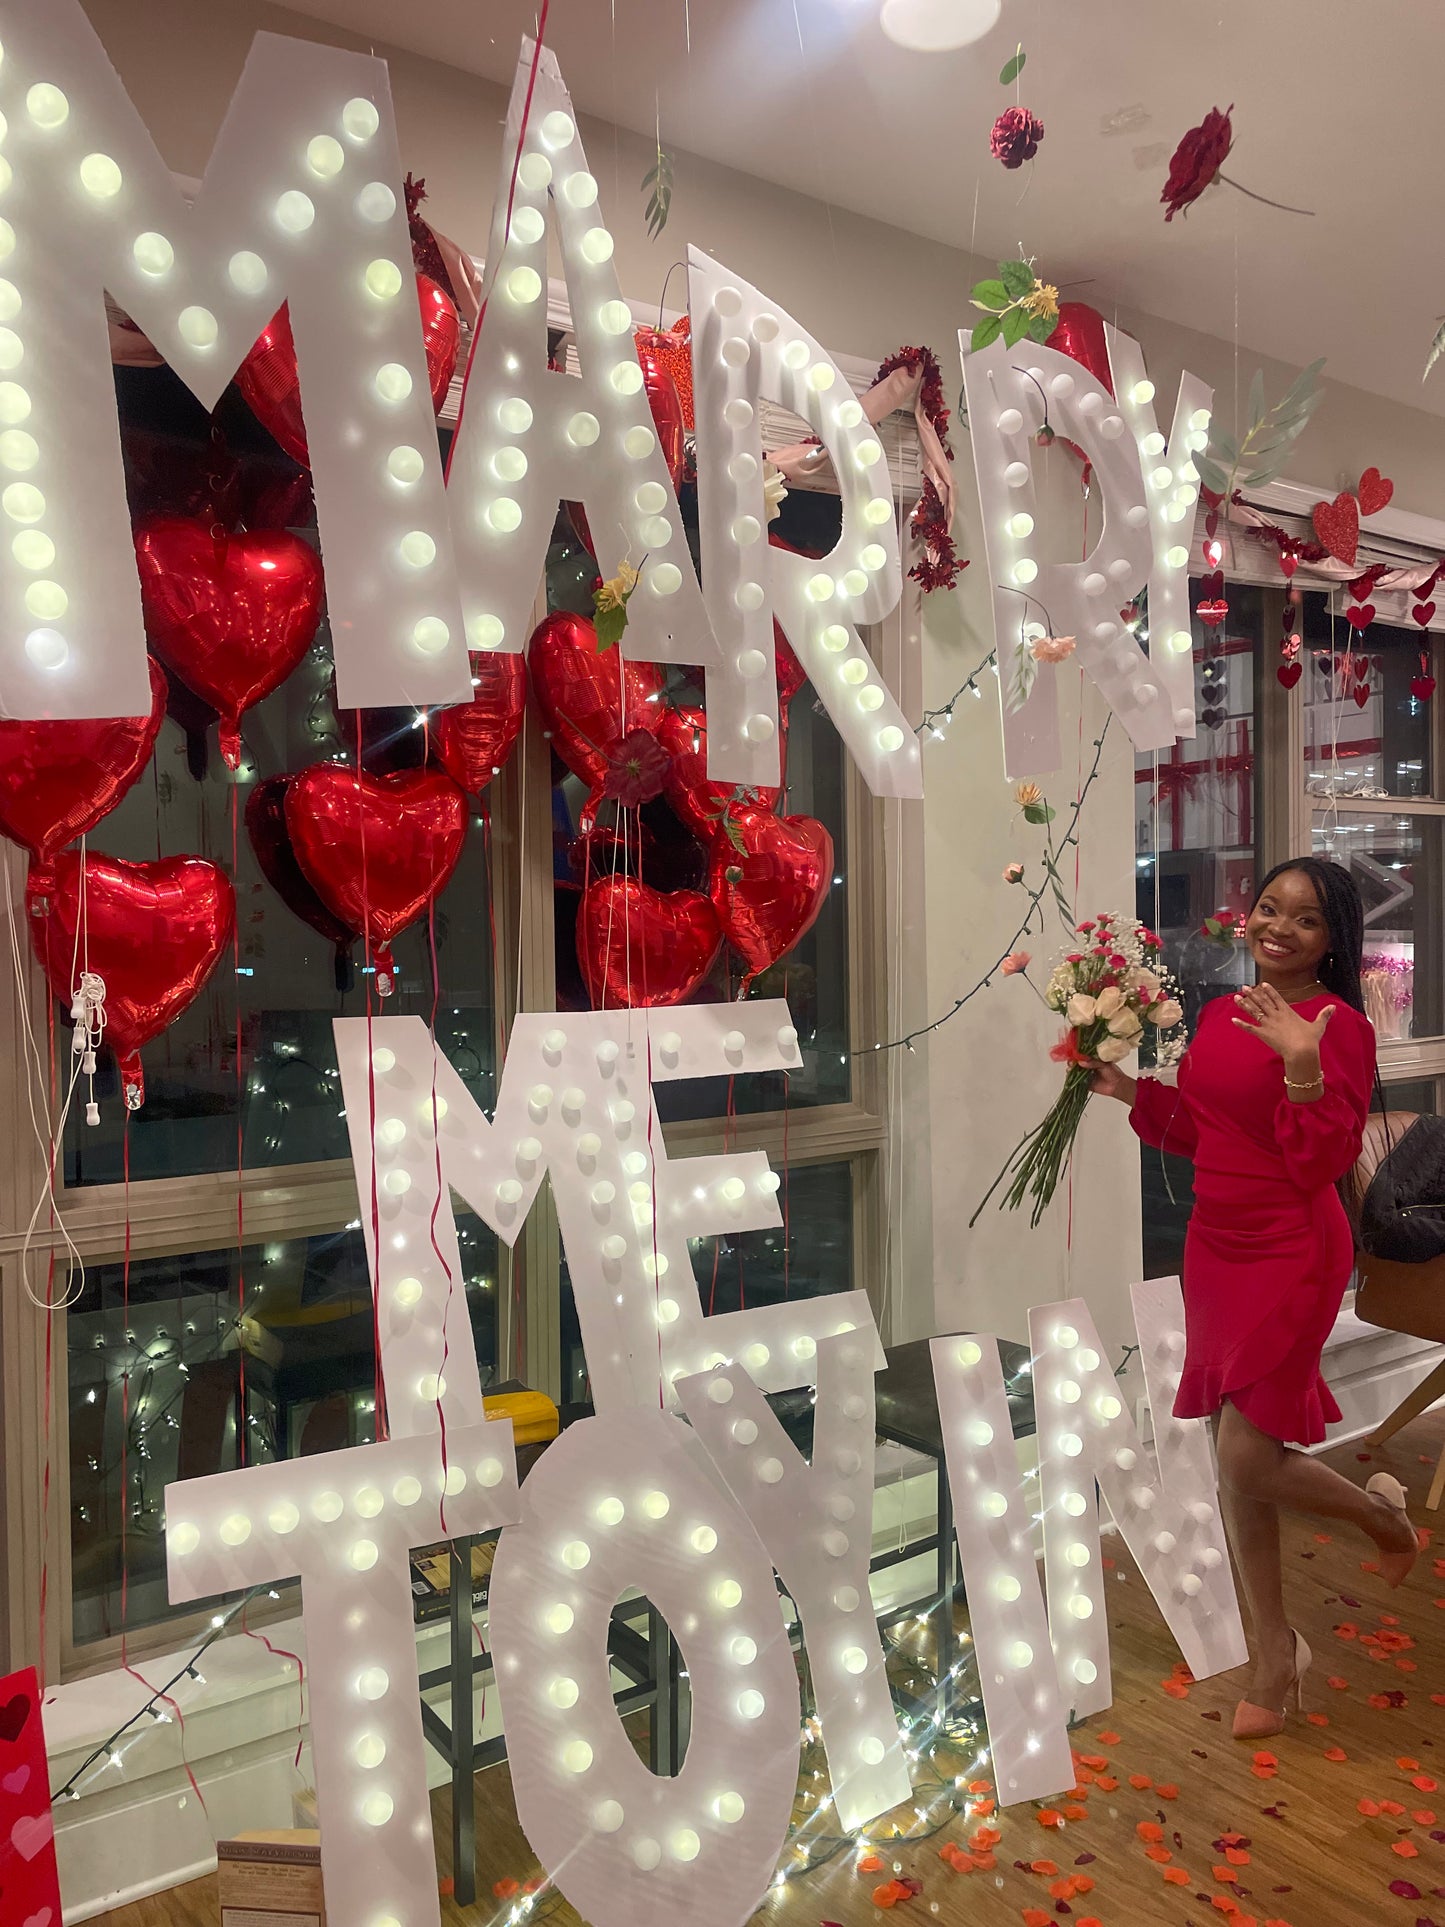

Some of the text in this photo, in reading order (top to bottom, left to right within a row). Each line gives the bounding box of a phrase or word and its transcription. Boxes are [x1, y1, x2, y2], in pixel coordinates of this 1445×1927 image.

[0, 0, 1214, 799] MARRY
[333, 998, 887, 1440] ME
[165, 1276, 1248, 1927] TOYIN
